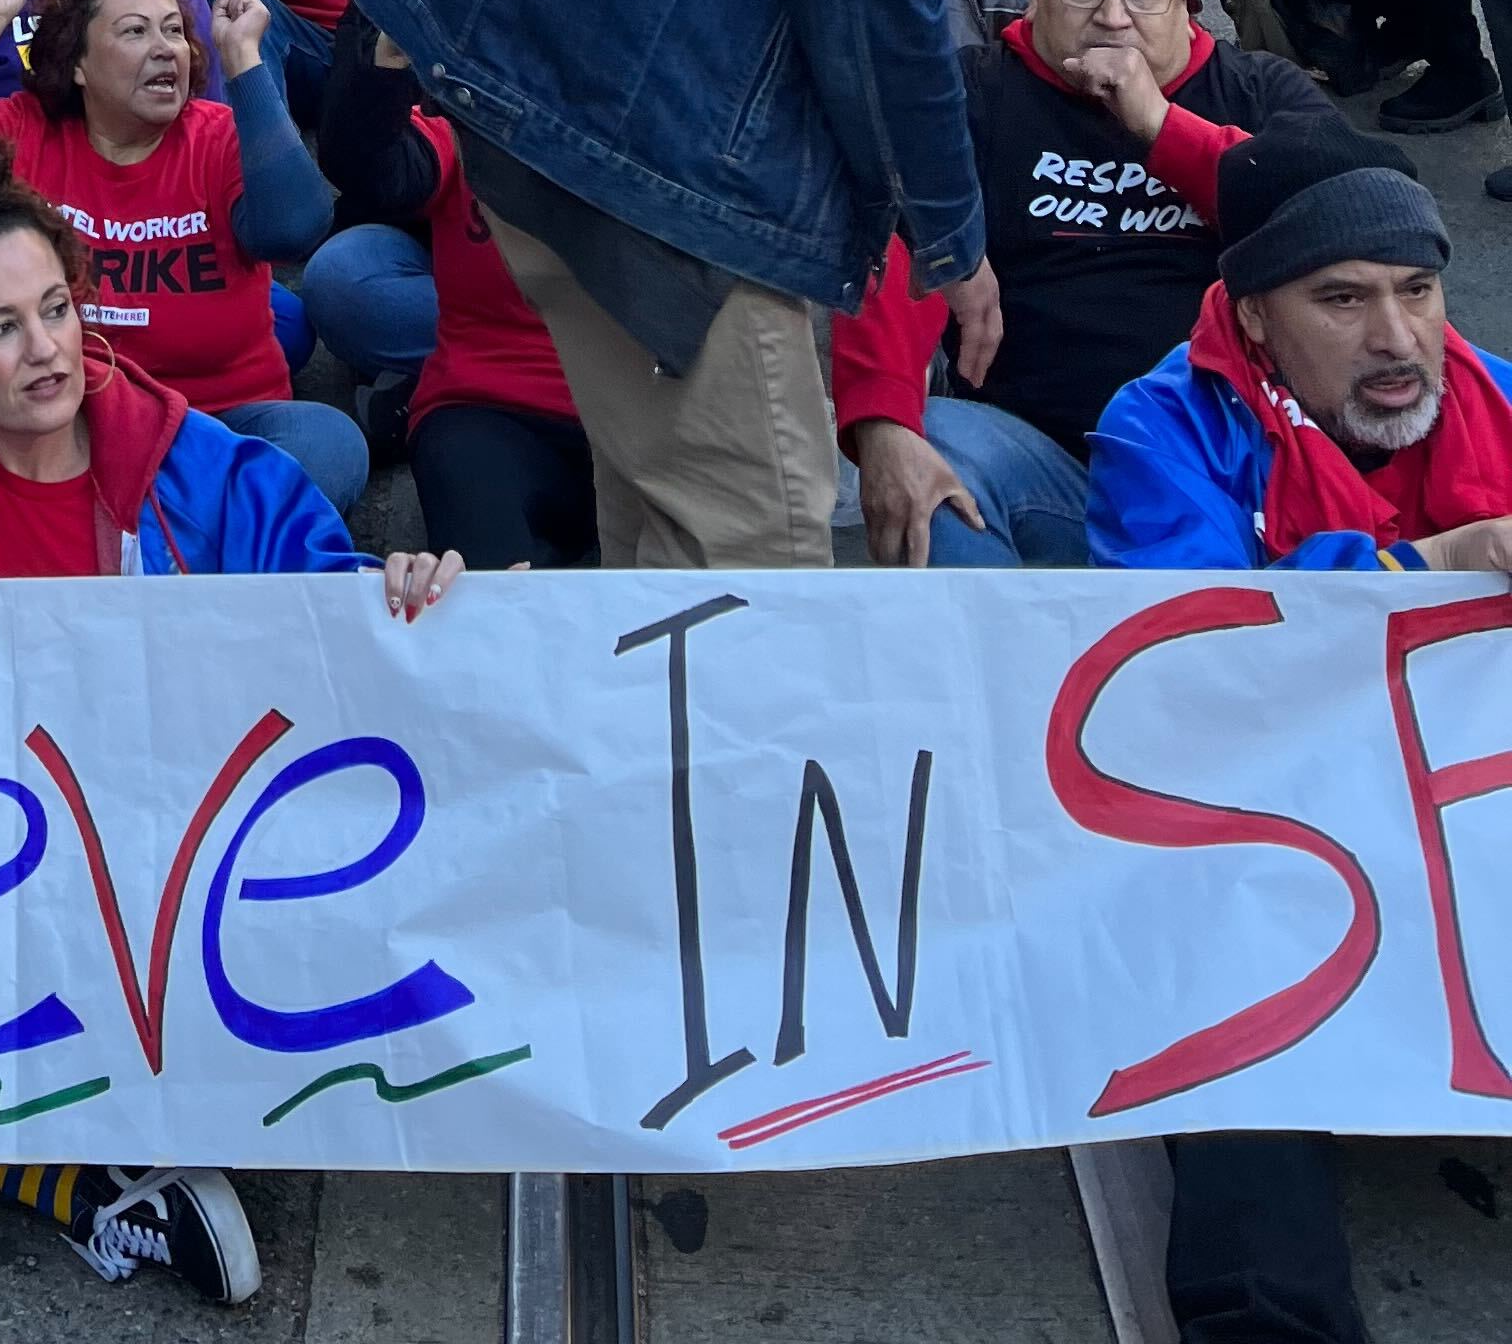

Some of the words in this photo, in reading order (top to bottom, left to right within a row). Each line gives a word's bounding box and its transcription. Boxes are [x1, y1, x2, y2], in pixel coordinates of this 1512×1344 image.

[1028, 195, 1108, 228] OUR
[1120, 203, 1205, 232] WOR
[1047, 588, 1512, 1118] SF
